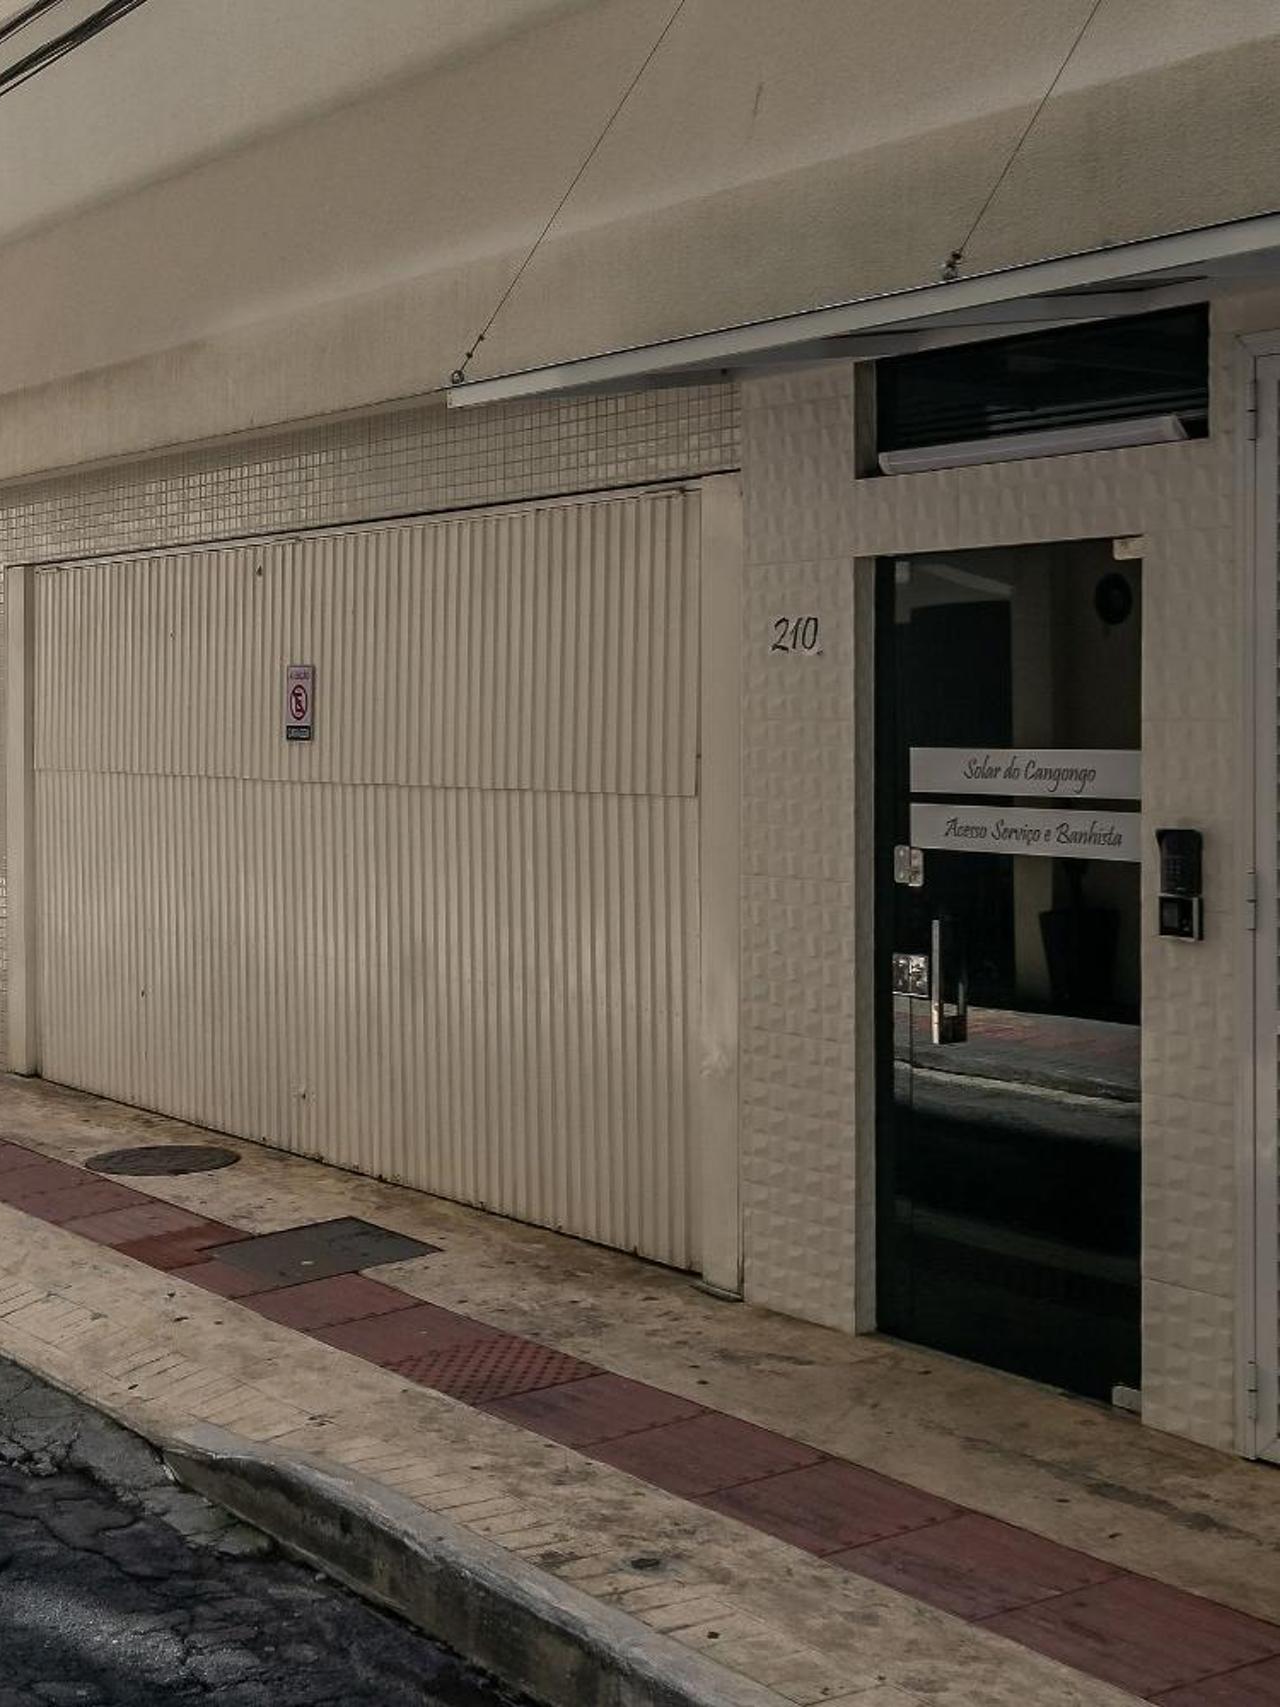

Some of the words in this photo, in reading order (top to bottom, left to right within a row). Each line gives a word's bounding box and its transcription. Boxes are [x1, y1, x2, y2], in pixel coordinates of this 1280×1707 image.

[771, 616, 818, 652] 210
[963, 755, 1001, 780] Solar
[1002, 755, 1020, 780] do
[1023, 759, 1096, 793] Cangongo
[945, 816, 987, 839] Acesso
[991, 819, 1040, 845] Serviço
[1043, 828, 1052, 842] e
[1055, 821, 1123, 847] Banhista
